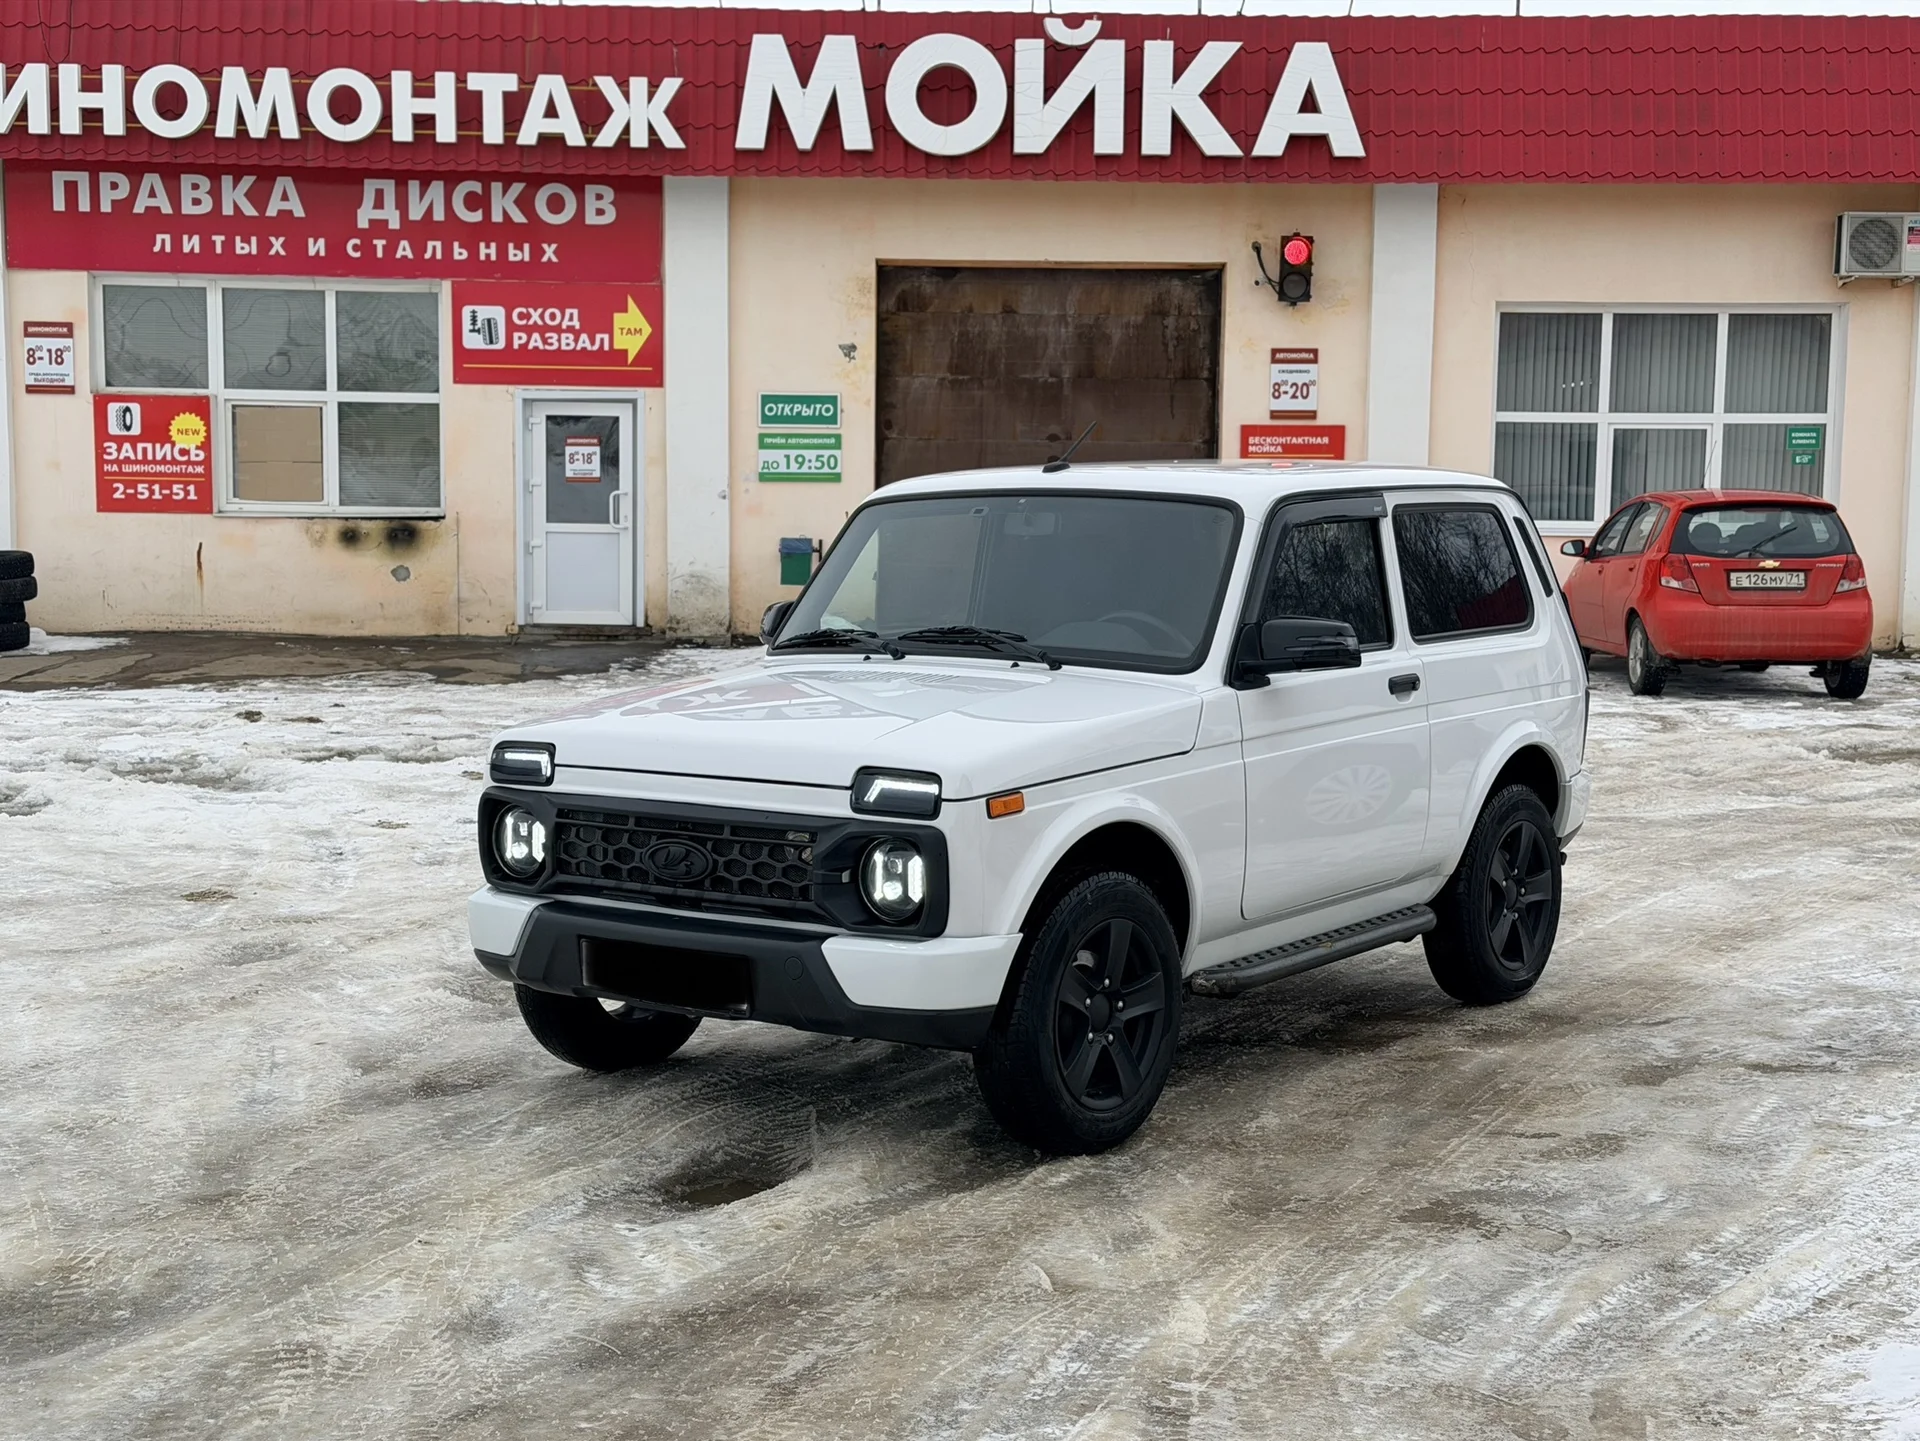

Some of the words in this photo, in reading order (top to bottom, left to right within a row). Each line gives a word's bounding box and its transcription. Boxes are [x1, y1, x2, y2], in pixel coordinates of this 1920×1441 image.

[735, 17, 1366, 158] МОЙКА
[0, 62, 686, 149] ИНОМОНТАЖ
[52, 170, 306, 217] ПРАВКА
[357, 178, 617, 229] ДИСКОВ
[153, 233, 286, 256] ЛИТЫХ
[308, 237, 326, 256] И
[346, 238, 559, 262] СТАЛЬНЫХ
[511, 307, 580, 329] СХОД
[618, 327, 643, 336] ТАМ
[512, 332, 610, 351] РАЗВАЛ
[764, 403, 834, 417] ОТКРЫТО
[176, 428, 201, 436] NEW
[1248, 436, 1330, 445] БЕСКОНТАКТНАЯ
[103, 441, 206, 461] ЗАПИСЬ
[1248, 444, 1283, 453] МОЙКА
[103, 464, 119, 472] НА
[122, 464, 206, 474] ШИНОМОНТАЖ
[783, 453, 839, 471] 19:50
[112, 482, 198, 500] 2-51-51
